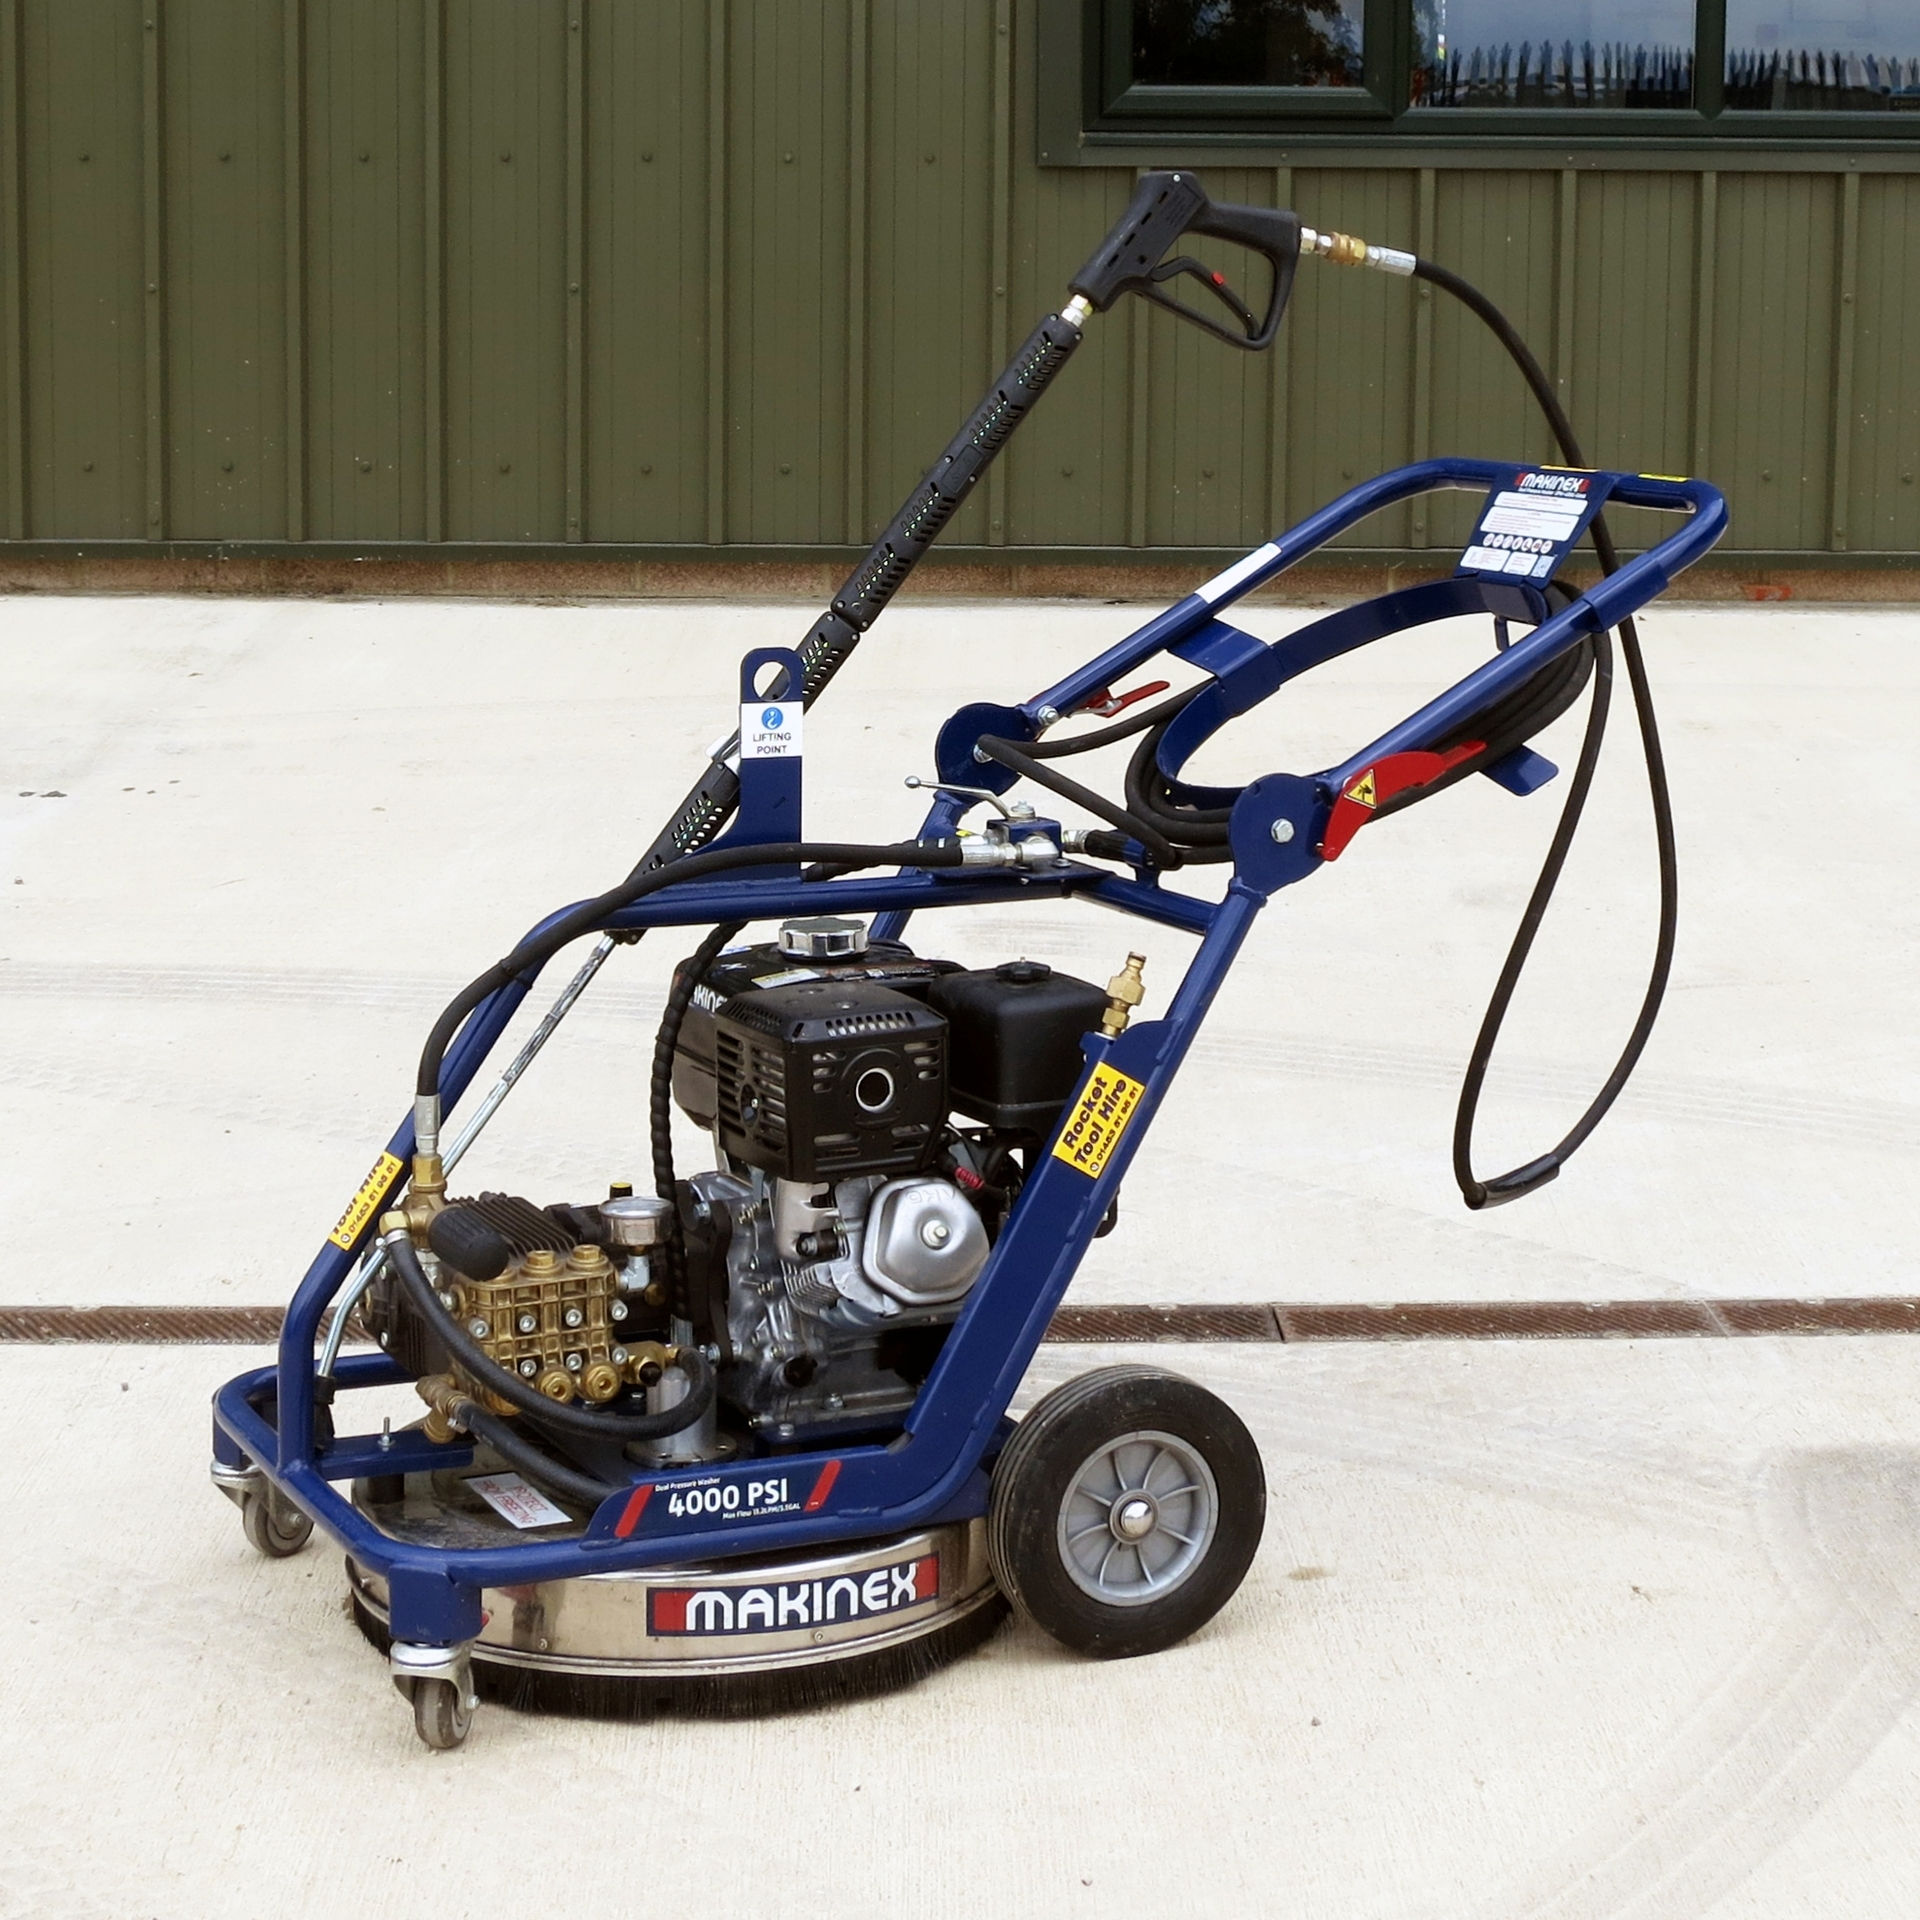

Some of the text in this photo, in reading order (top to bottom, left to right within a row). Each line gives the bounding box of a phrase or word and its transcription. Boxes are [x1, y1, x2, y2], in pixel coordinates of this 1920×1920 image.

[1521, 473, 1584, 492] MAKINEX
[753, 732, 791, 742] LIFTING
[757, 745, 788, 754] POINT
[1063, 1077, 1107, 1149] Rocket
[1074, 1079, 1126, 1164] Tool Hire
[668, 1478, 787, 1517] 4000 PSI
[685, 1562, 917, 1631] MAKINEX
